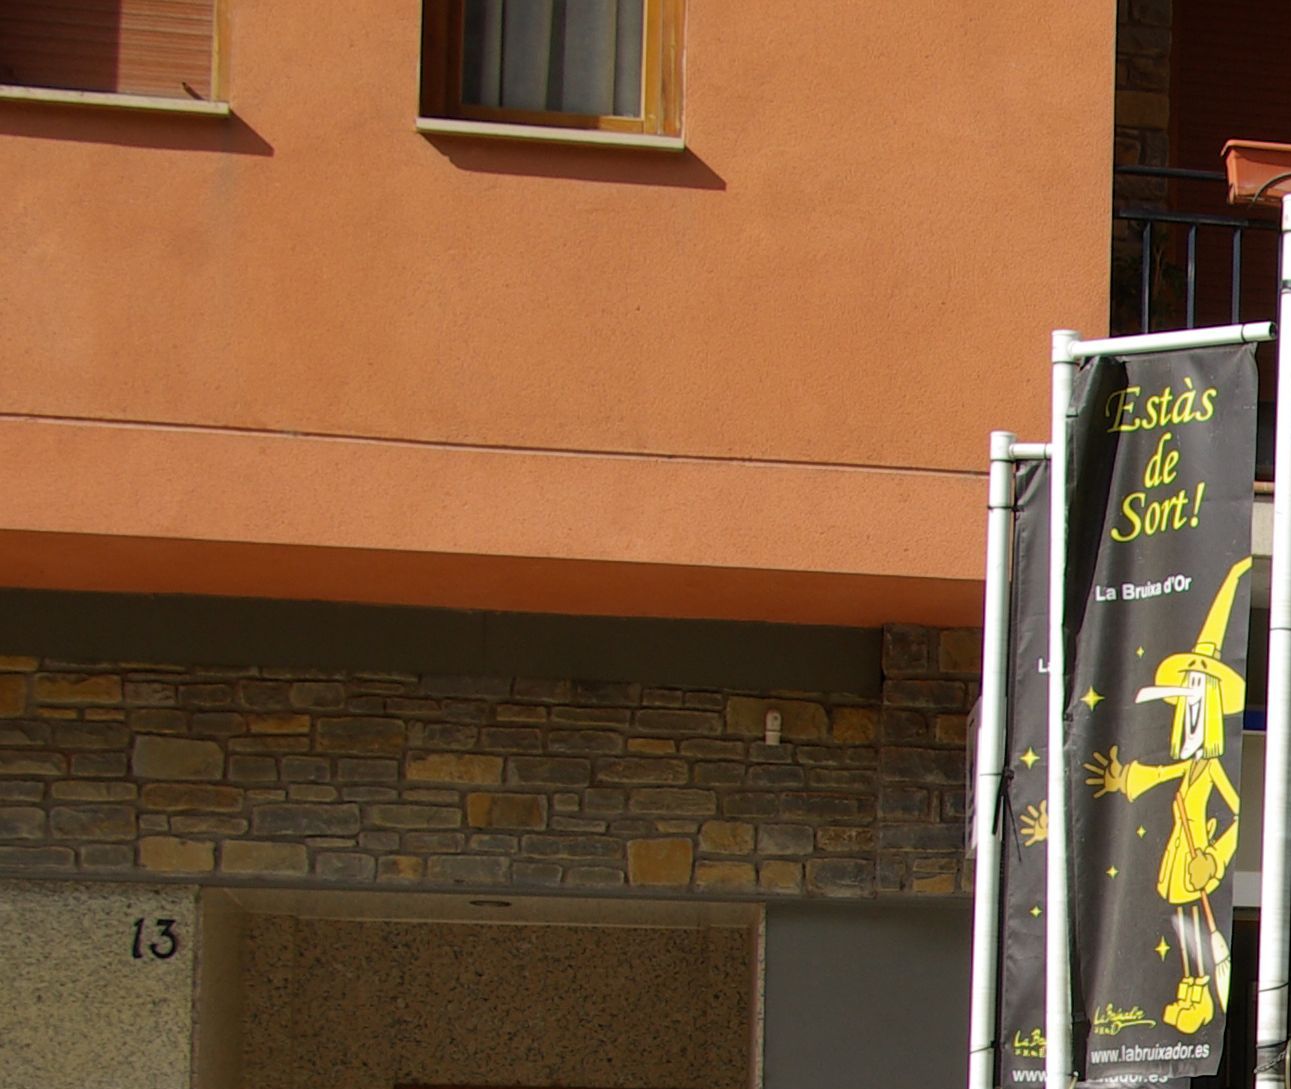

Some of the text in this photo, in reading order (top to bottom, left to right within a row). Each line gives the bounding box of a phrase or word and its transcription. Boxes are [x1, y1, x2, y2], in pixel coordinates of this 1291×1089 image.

[1105, 377, 1217, 433] Estàs
[1144, 432, 1179, 488] de
[1111, 482, 1206, 542] Sort!
[1096, 574, 1191, 601] La Bruixa d'Or
[132, 917, 177, 959] 13
[1091, 1043, 1210, 1064] www.labruixador.es
